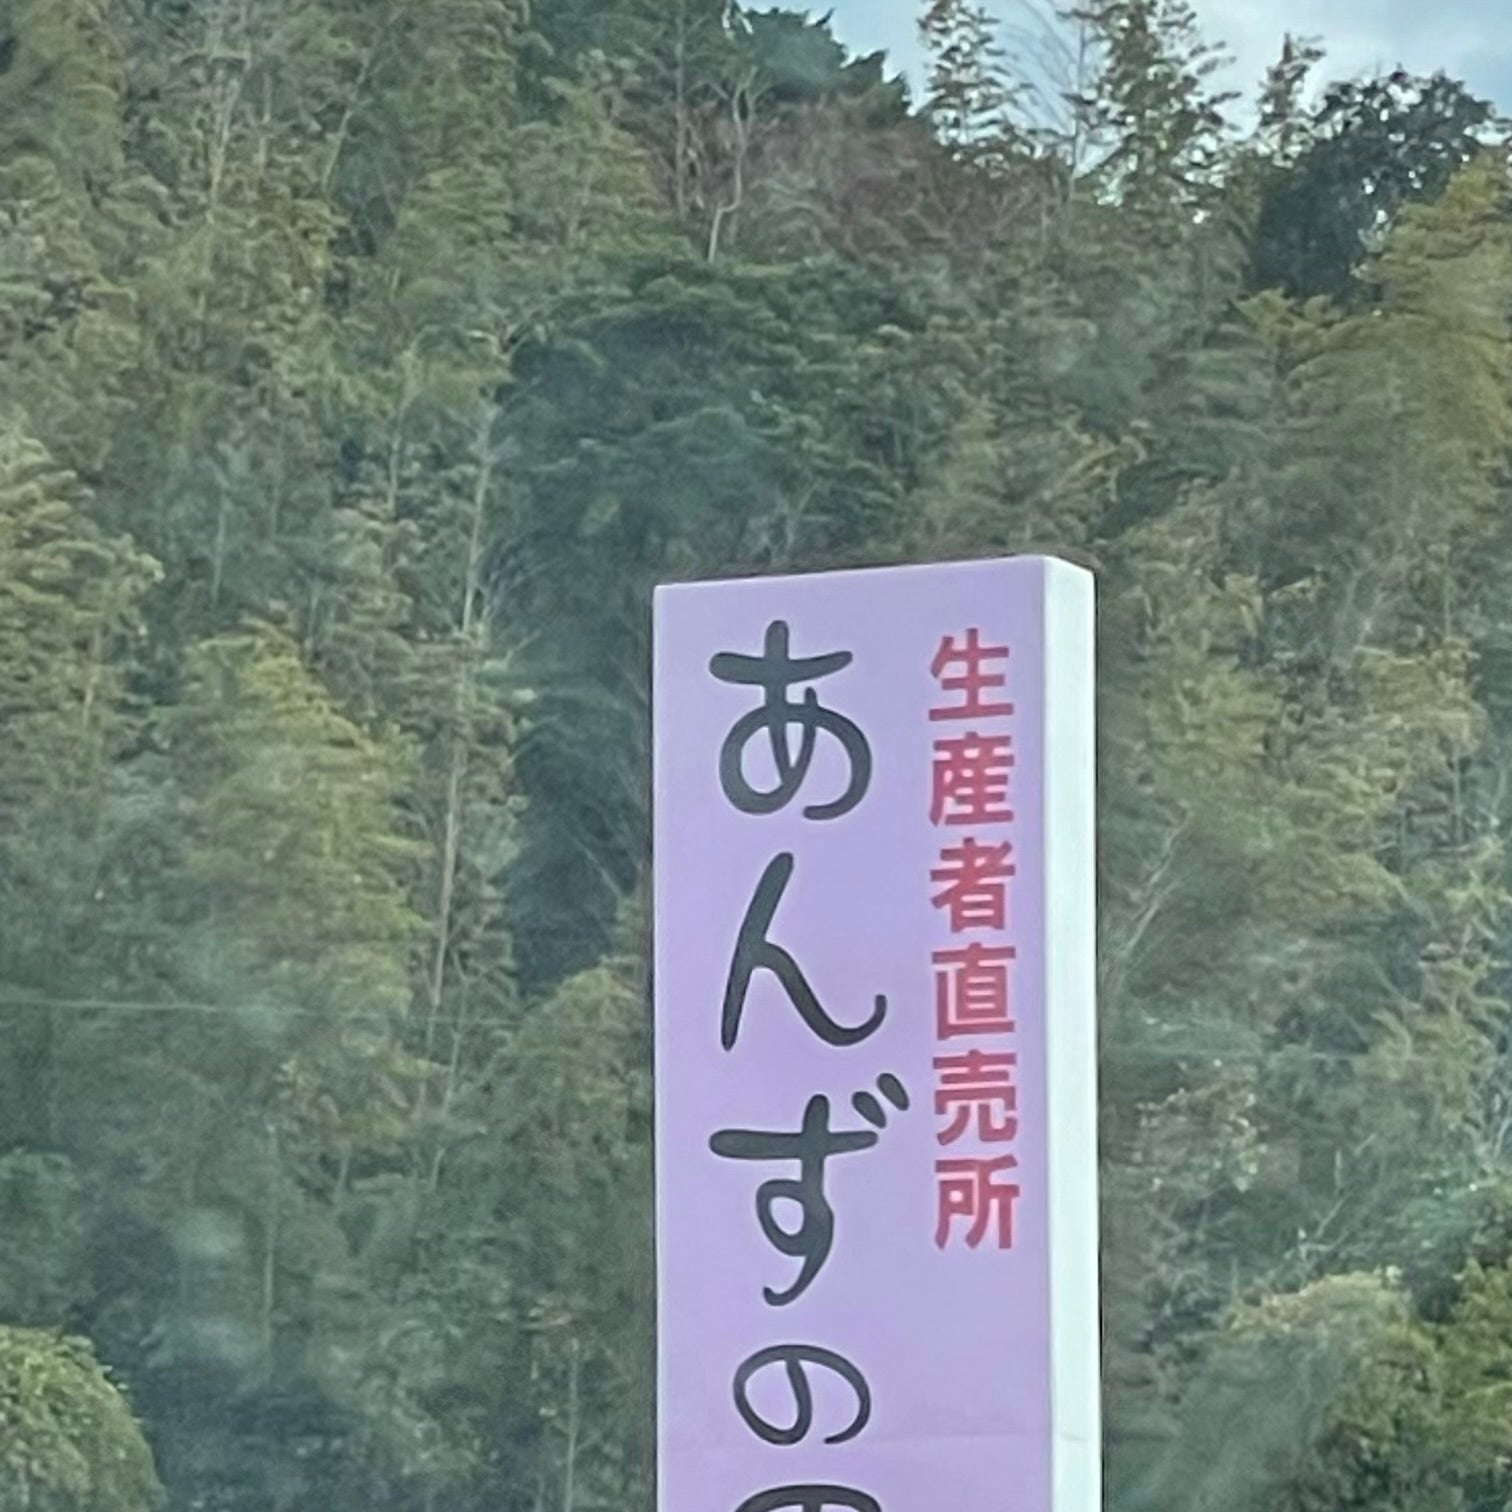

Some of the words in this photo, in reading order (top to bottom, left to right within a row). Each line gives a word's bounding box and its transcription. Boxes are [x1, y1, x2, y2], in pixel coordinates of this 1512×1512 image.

[928, 627, 1020, 1251] 生産者直売所
